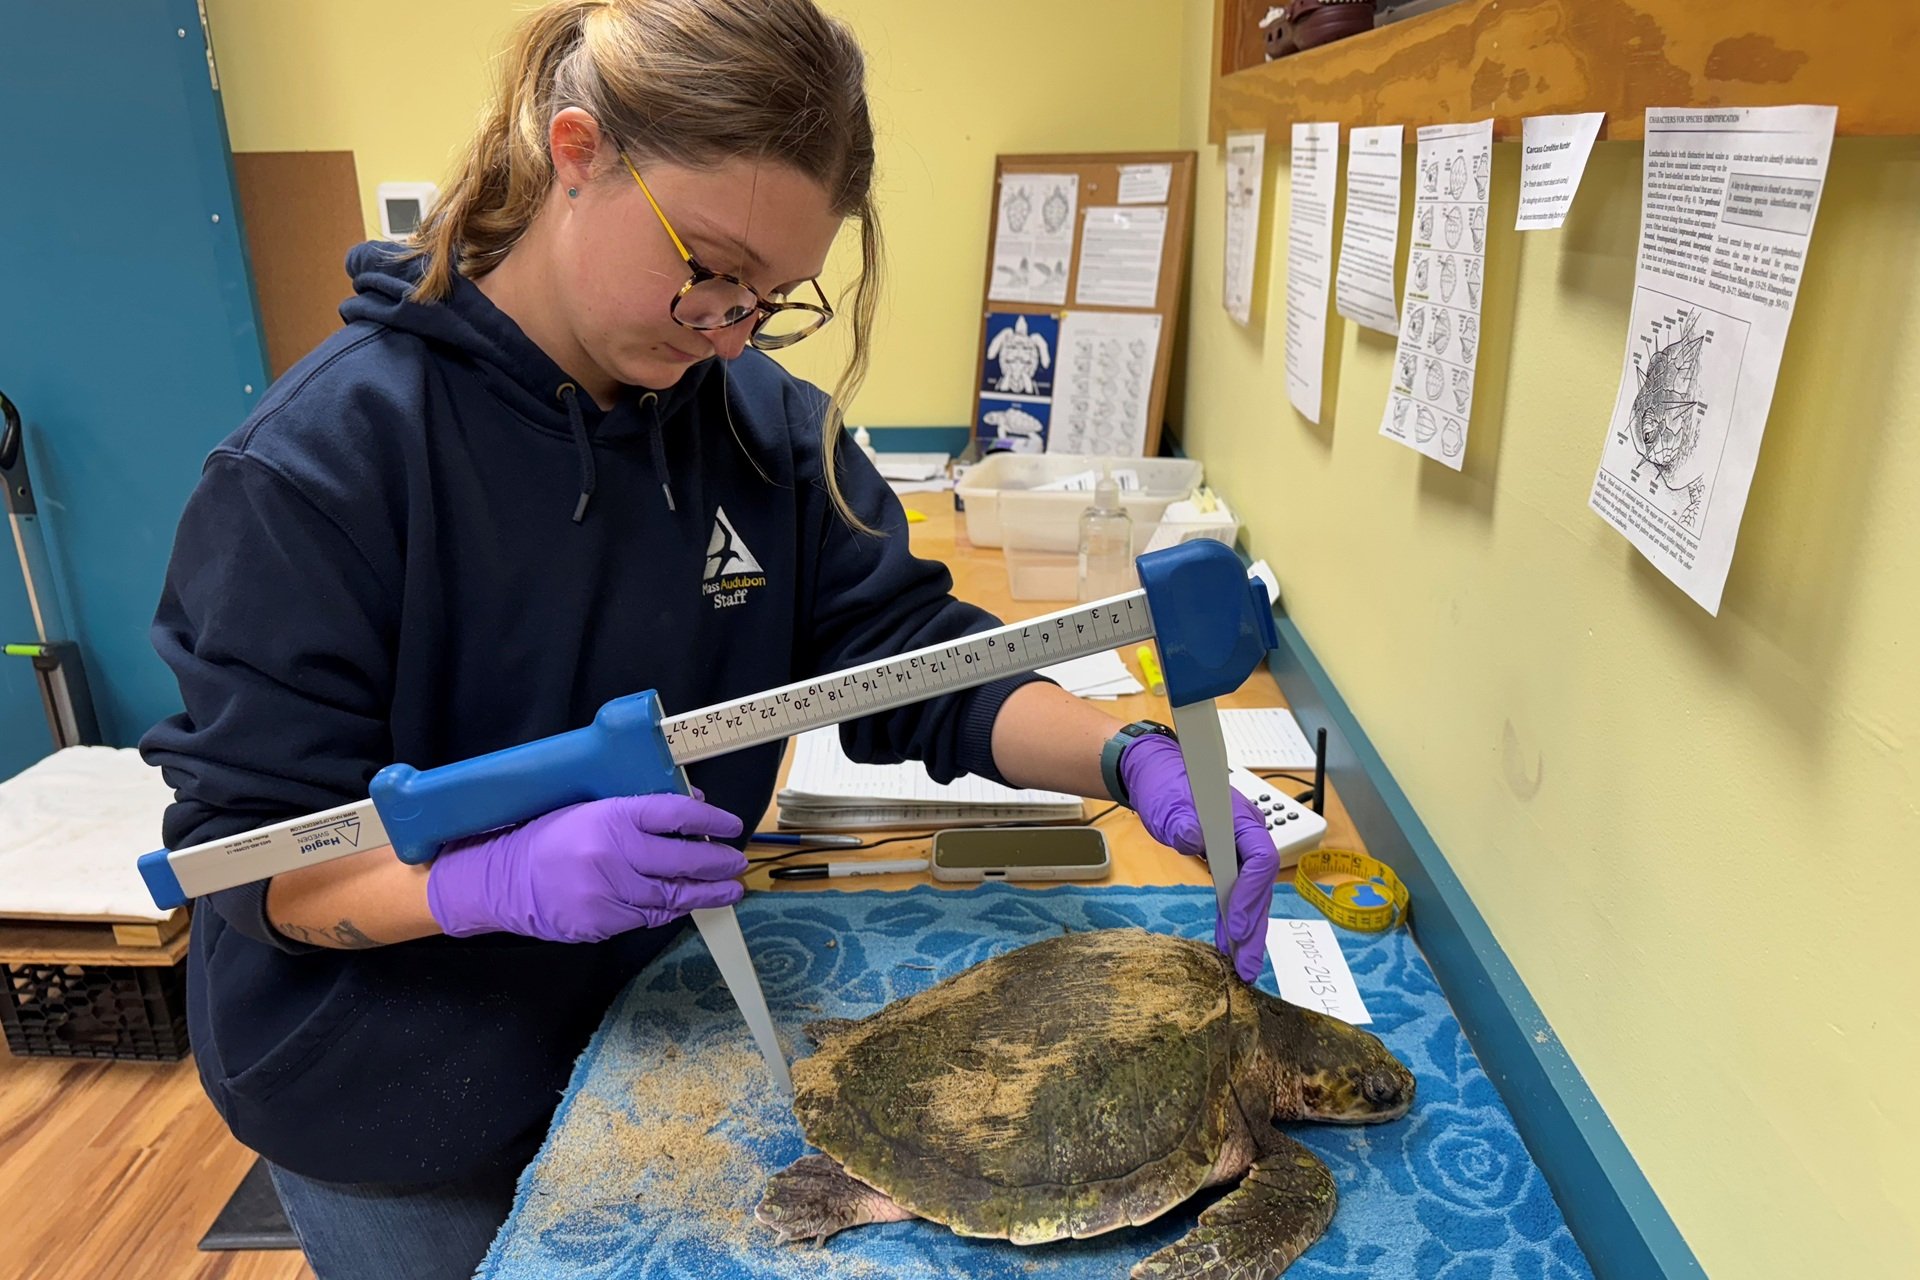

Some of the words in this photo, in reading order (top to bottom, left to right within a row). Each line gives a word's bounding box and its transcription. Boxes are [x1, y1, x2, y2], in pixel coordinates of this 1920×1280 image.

[1686, 115, 1702, 123] SPECIES
[1704, 114, 1739, 123] IDENTIFICATION
[1526, 146, 1543, 154] Carcass
[1543, 143, 1559, 152] Condition
[703, 582, 720, 596] Mass
[721, 576, 766, 590] Audubon
[714, 588, 748, 609] Staff
[1127, 600, 1133, 609] 1
[1092, 609, 1100, 619] 3
[1112, 614, 1120, 624] 2
[1057, 618, 1064, 628] 5
[1023, 628, 1030, 638] 7
[1077, 624, 1084, 634] 4
[988, 637, 995, 647] 9
[1042, 633, 1049, 643] 6
[946, 647, 960, 658] 11
[1008, 642, 1015, 652] 8
[910, 656, 926, 668] 13
[965, 652, 980, 664] 10
[876, 665, 892, 677] 15
[930, 661, 946, 673] 12
[843, 675, 858, 686] 17
[896, 670, 912, 682] 14
[809, 684, 823, 696] 19
[862, 680, 878, 691] 16
[775, 693, 790, 704] 21
[828, 689, 844, 701] 18
[740, 702, 756, 714] 23
[794, 698, 810, 710] 20
[706, 712, 722, 723] 25
[760, 707, 776, 719] 22
[673, 720, 688, 732] 27
[726, 716, 743, 728] 24
[692, 726, 708, 737] 26
[667, 734, 674, 744] 2
[297, 831, 330, 843] SWEDEN
[300, 836, 341, 854] Haglöf
[1289, 920, 1337, 996] ST2025-243
